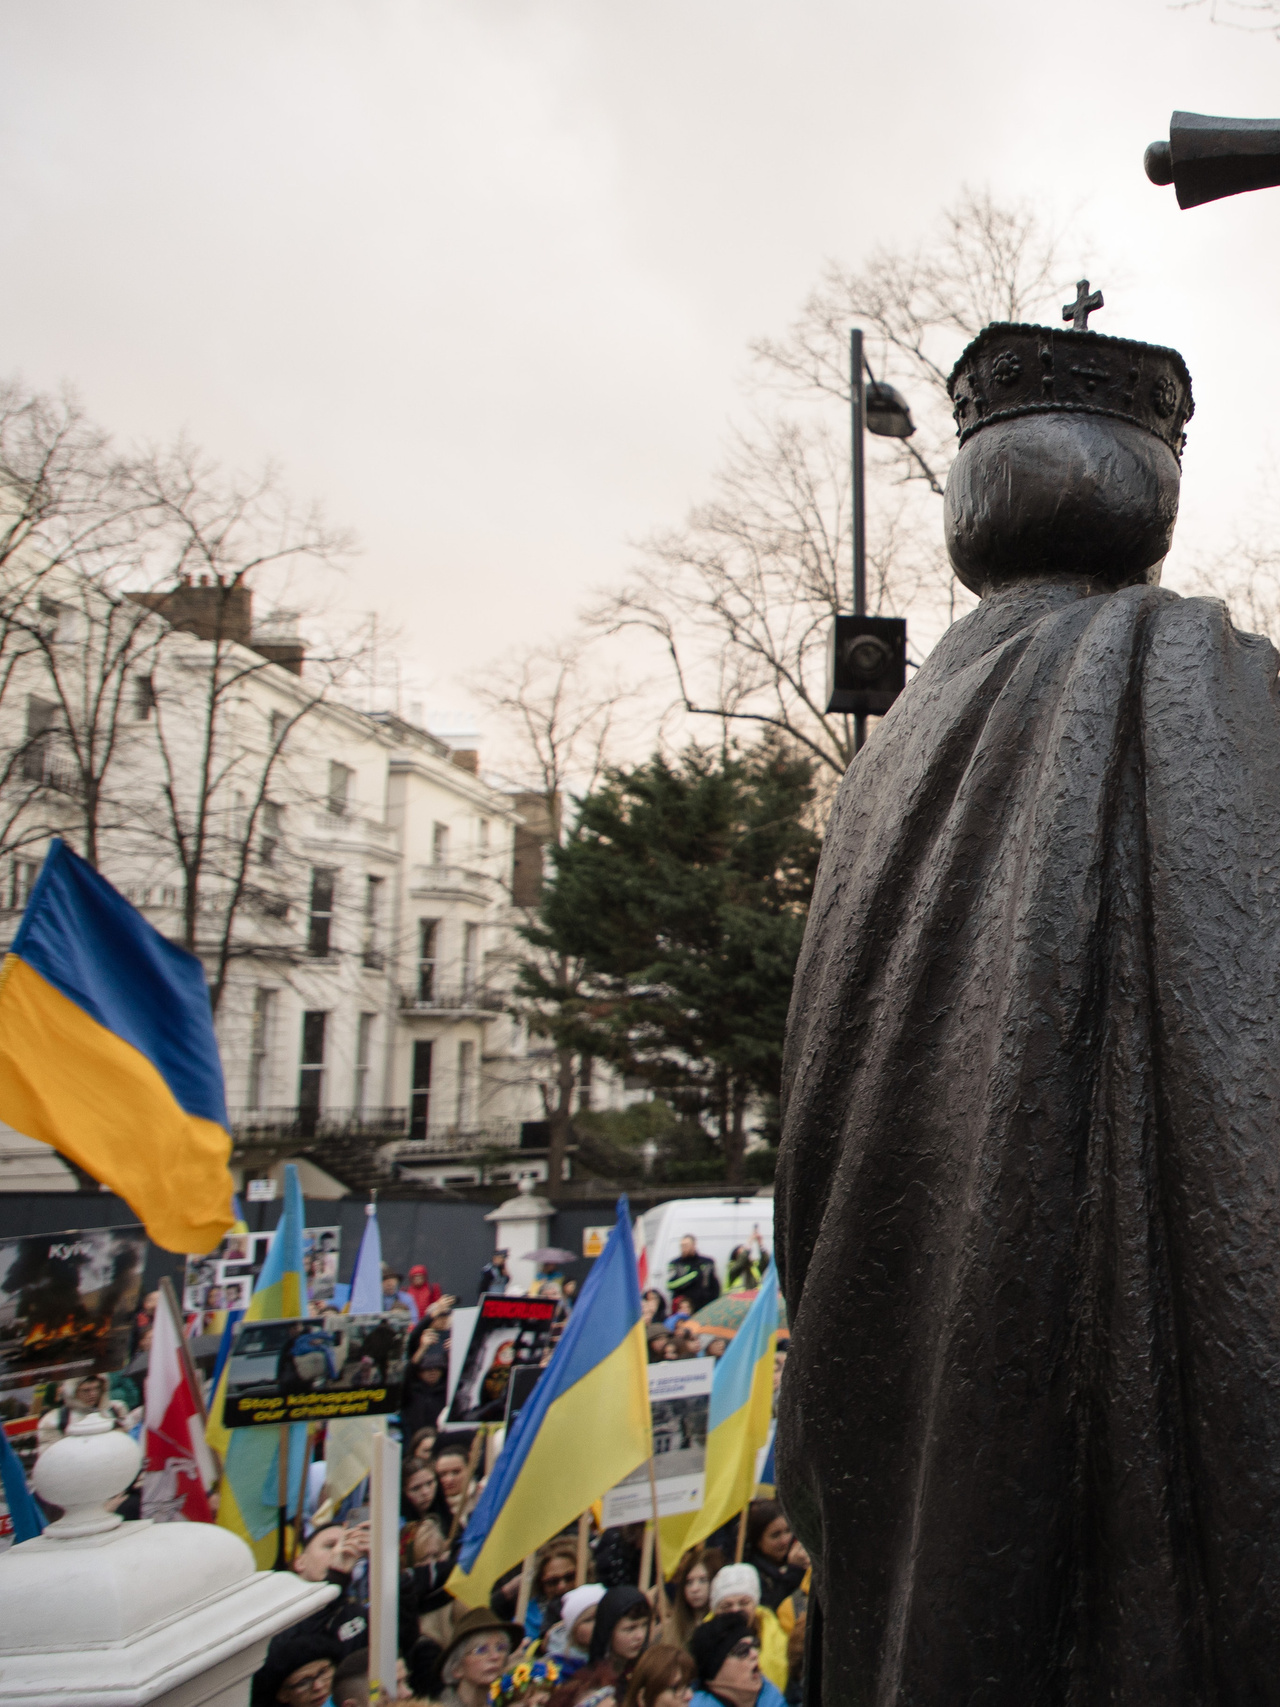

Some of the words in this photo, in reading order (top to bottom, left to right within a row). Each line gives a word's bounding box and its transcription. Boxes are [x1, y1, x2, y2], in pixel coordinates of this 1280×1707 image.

[48, 1241, 92, 1260] Kyiv
[238, 1397, 284, 1411] Stop
[286, 1388, 387, 1406] kidnapping
[252, 1409, 287, 1422] our
[289, 1400, 369, 1419] children!
